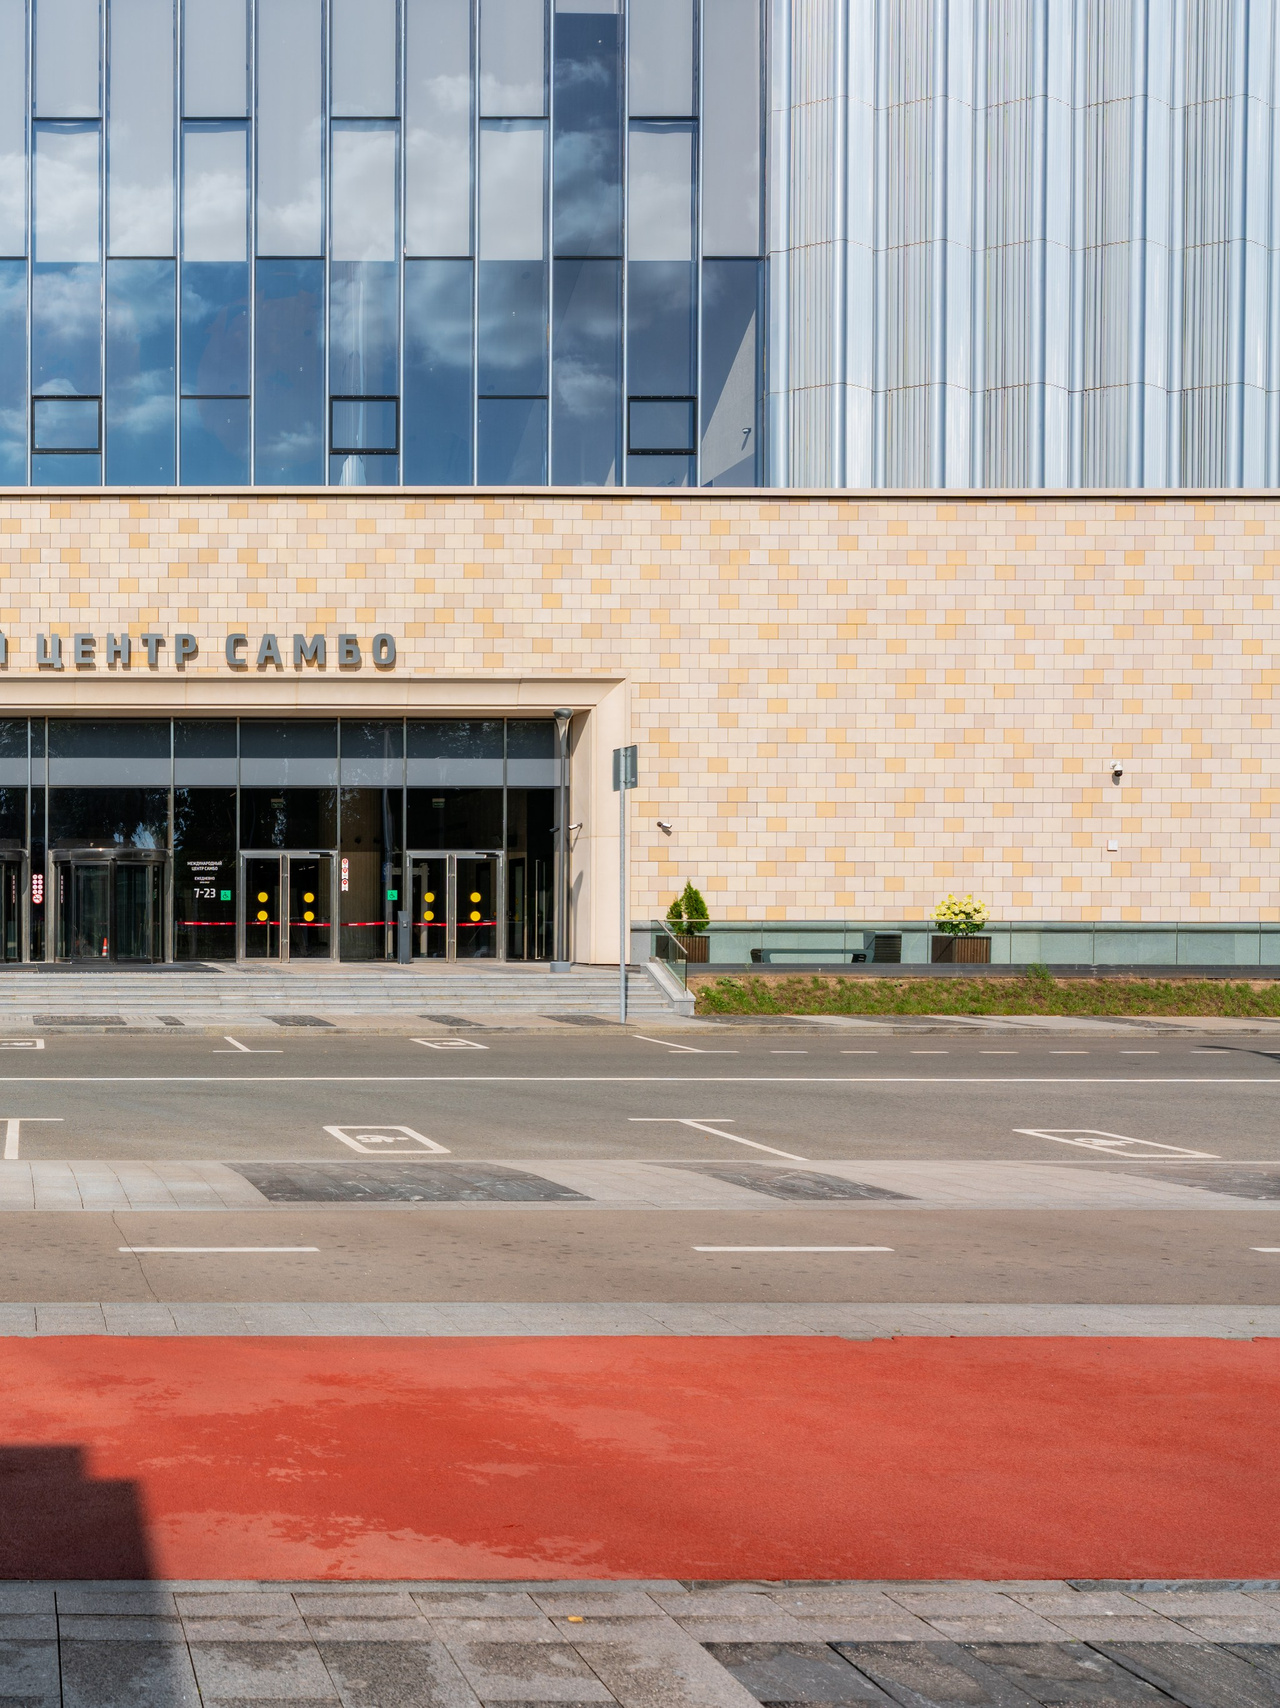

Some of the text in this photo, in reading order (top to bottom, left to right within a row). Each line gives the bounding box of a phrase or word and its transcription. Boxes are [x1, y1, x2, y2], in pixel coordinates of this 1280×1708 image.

[36, 633, 197, 669] ЦЕНТР
[225, 633, 397, 665] САМБО
[193, 888, 216, 898] 7-23
